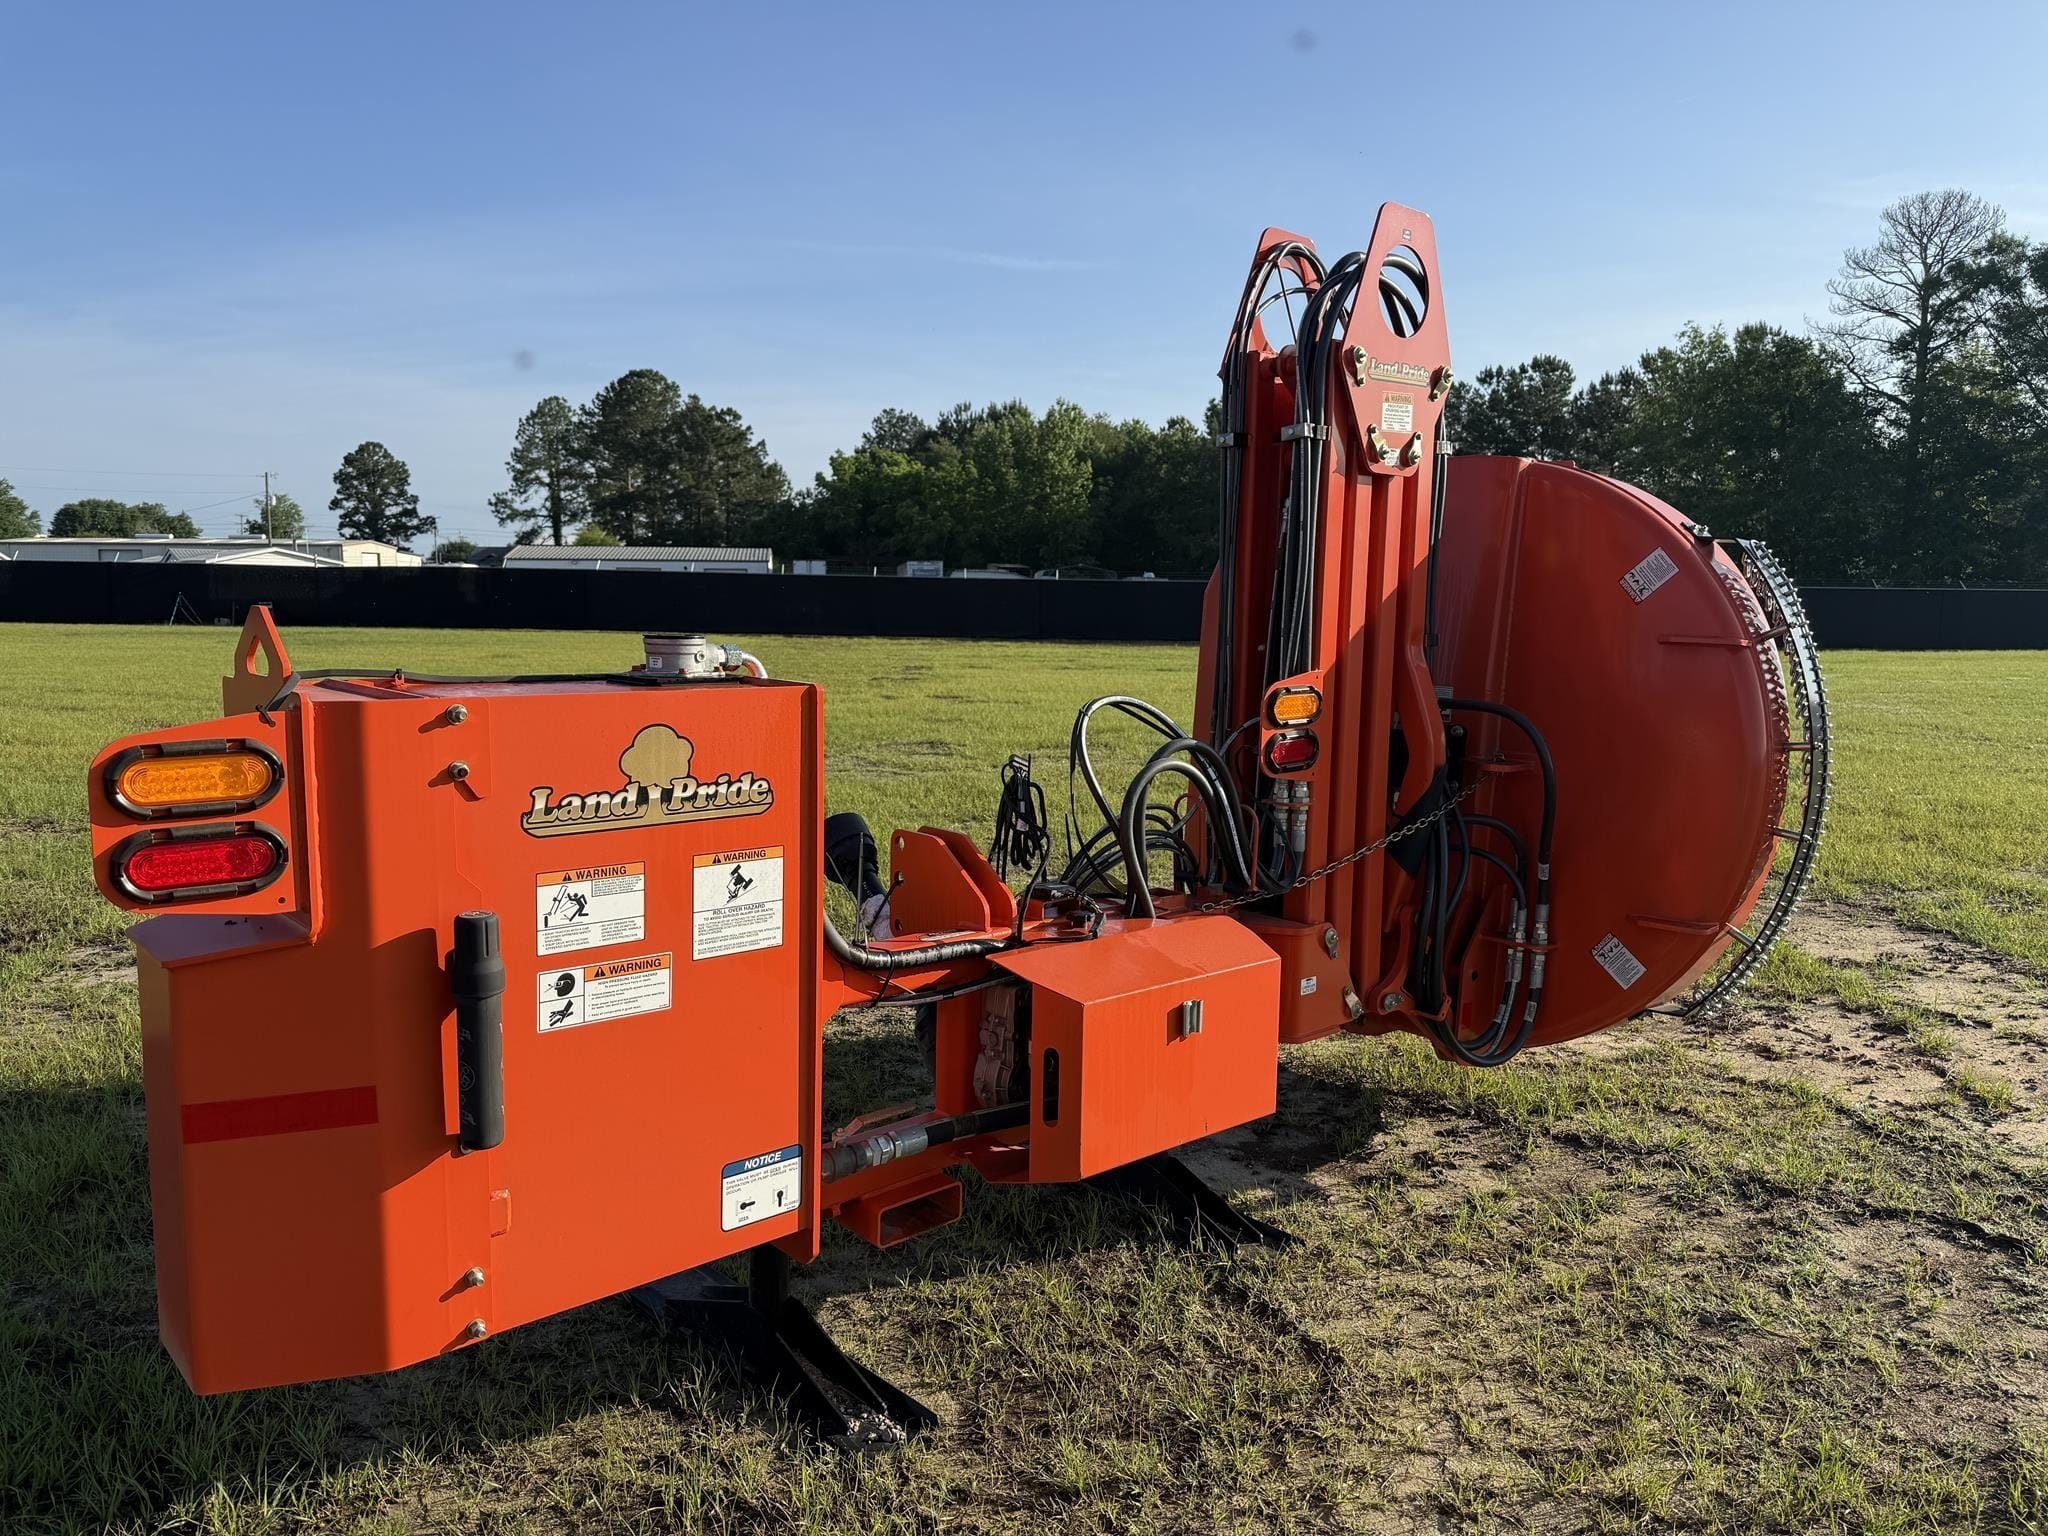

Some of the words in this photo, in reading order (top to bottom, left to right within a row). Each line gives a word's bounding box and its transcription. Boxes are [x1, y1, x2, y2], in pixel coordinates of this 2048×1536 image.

[1370, 358, 1398, 373] Land
[1402, 364, 1429, 380] Pride
[1390, 393, 1412, 404] WARNING
[527, 781, 640, 823] Land
[667, 773, 771, 810] Pride
[723, 849, 766, 862] WARNING
[576, 866, 627, 880] WARNING
[744, 903, 765, 911] HAZARD
[609, 959, 661, 974] WARNING
[744, 1151, 782, 1170] NOTICE
